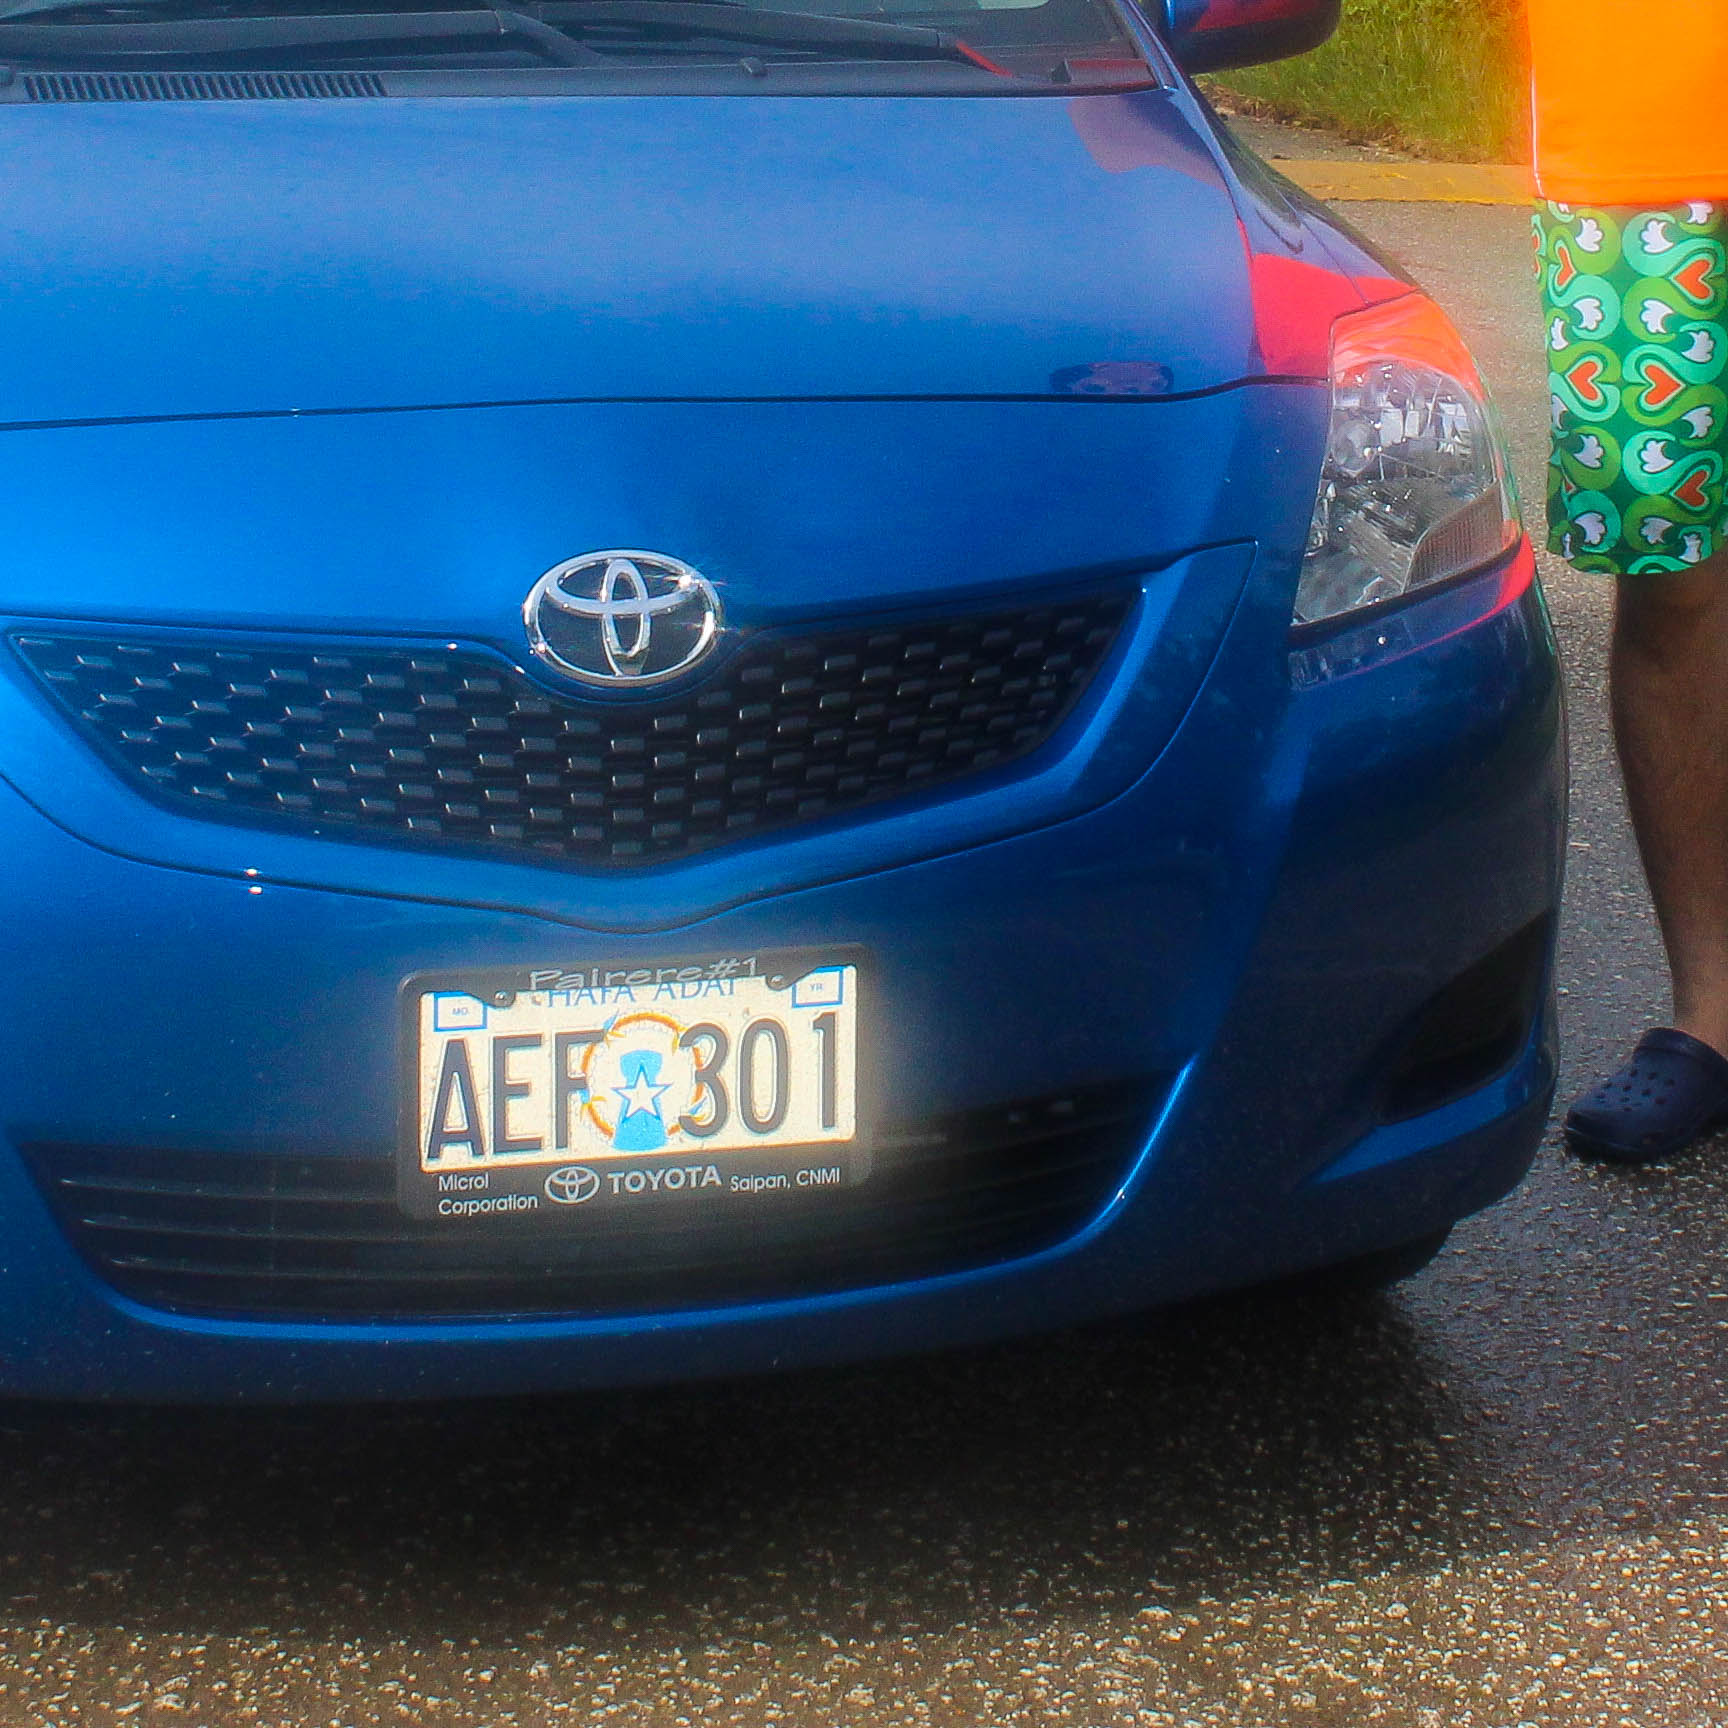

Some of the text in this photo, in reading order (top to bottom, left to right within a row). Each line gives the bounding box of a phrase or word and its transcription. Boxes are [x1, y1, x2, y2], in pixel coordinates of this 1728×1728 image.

[427, 1011, 839, 1161] AEF 301
[438, 1172, 490, 1193] Microl
[607, 1165, 841, 1195] TOYOTA Saipan, CNMI
[438, 1193, 538, 1217] Corporation
